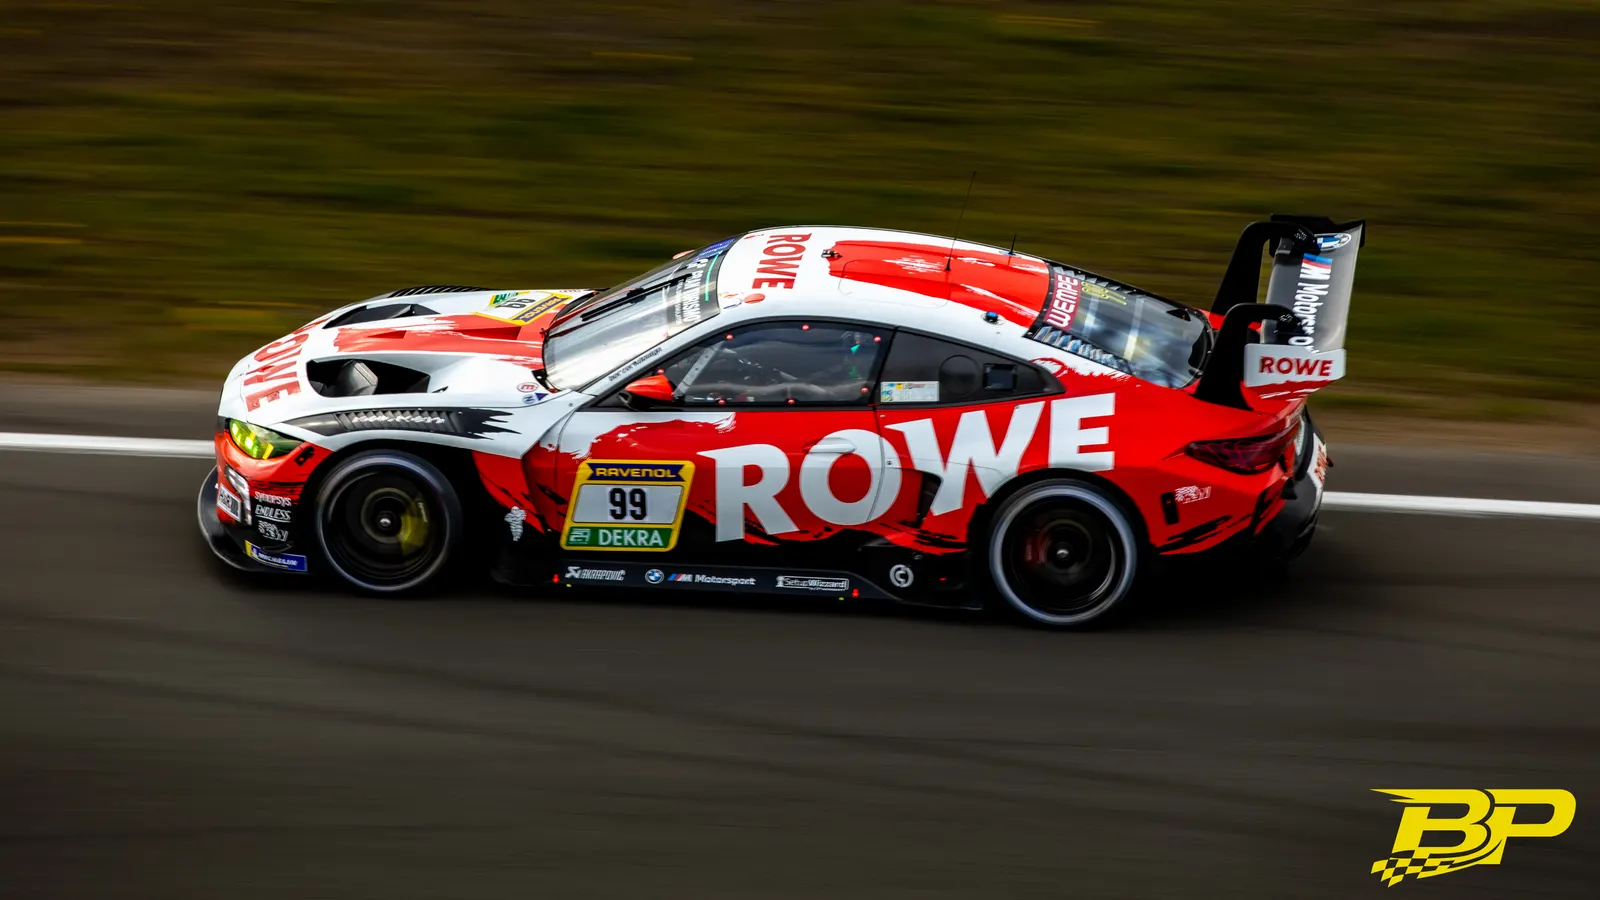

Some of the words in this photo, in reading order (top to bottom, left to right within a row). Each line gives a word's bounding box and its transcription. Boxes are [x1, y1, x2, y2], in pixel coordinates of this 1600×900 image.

[752, 233, 812, 289] ROWE
[1047, 275, 1078, 328] WEMPE
[1259, 356, 1333, 376] ROWE
[595, 467, 677, 478] RAVENOL
[697, 392, 1116, 542] ROWE
[254, 504, 292, 521] ENDLESS
[609, 487, 648, 521] 99
[598, 529, 664, 547] DEKRA
[694, 574, 756, 586] Motorsport
